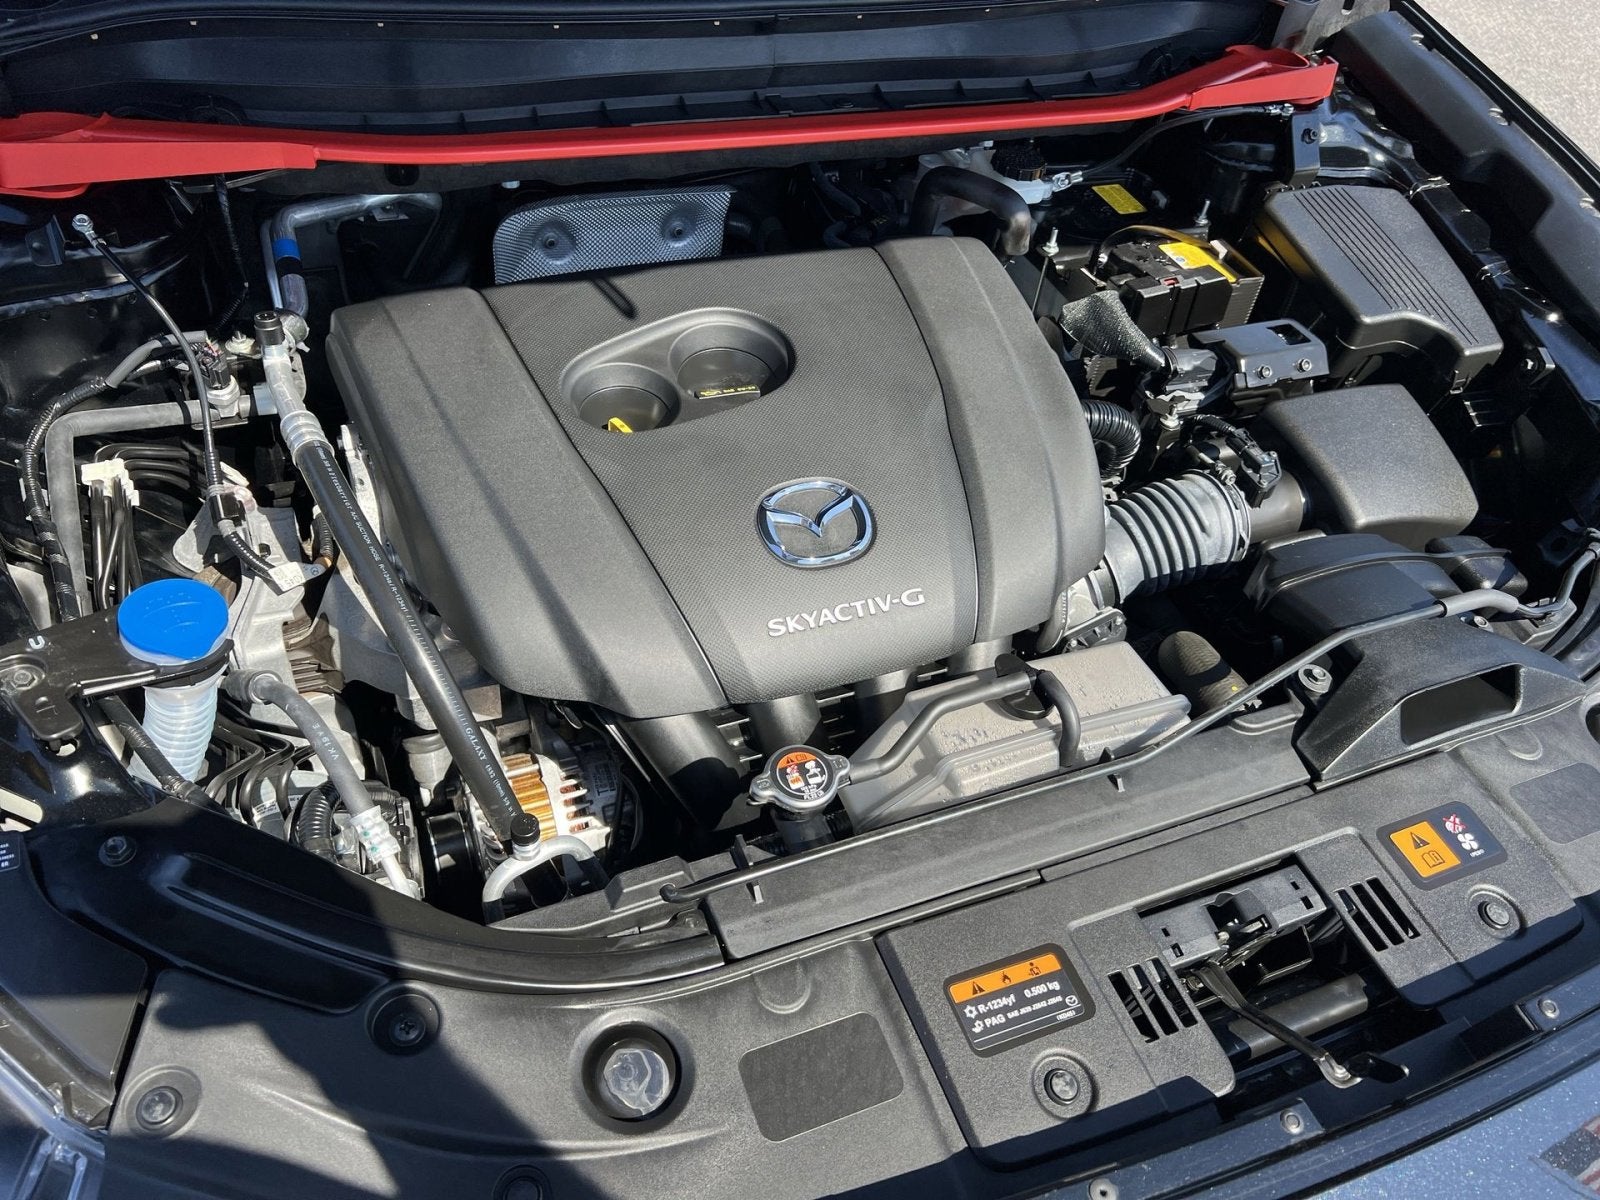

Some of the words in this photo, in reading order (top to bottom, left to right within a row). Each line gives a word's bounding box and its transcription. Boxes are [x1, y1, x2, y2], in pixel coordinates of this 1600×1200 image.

[355, 521, 371, 544] SUCTION
[369, 546, 381, 562] HOSE
[767, 588, 926, 638] SKYACTIV-G
[465, 727, 487, 761] GALAXY
[978, 994, 1016, 1014] R-1234yf
[1024, 983, 1048, 998] 0.500
[1048, 980, 1060, 993] kg
[984, 1014, 1006, 1028] PAG
